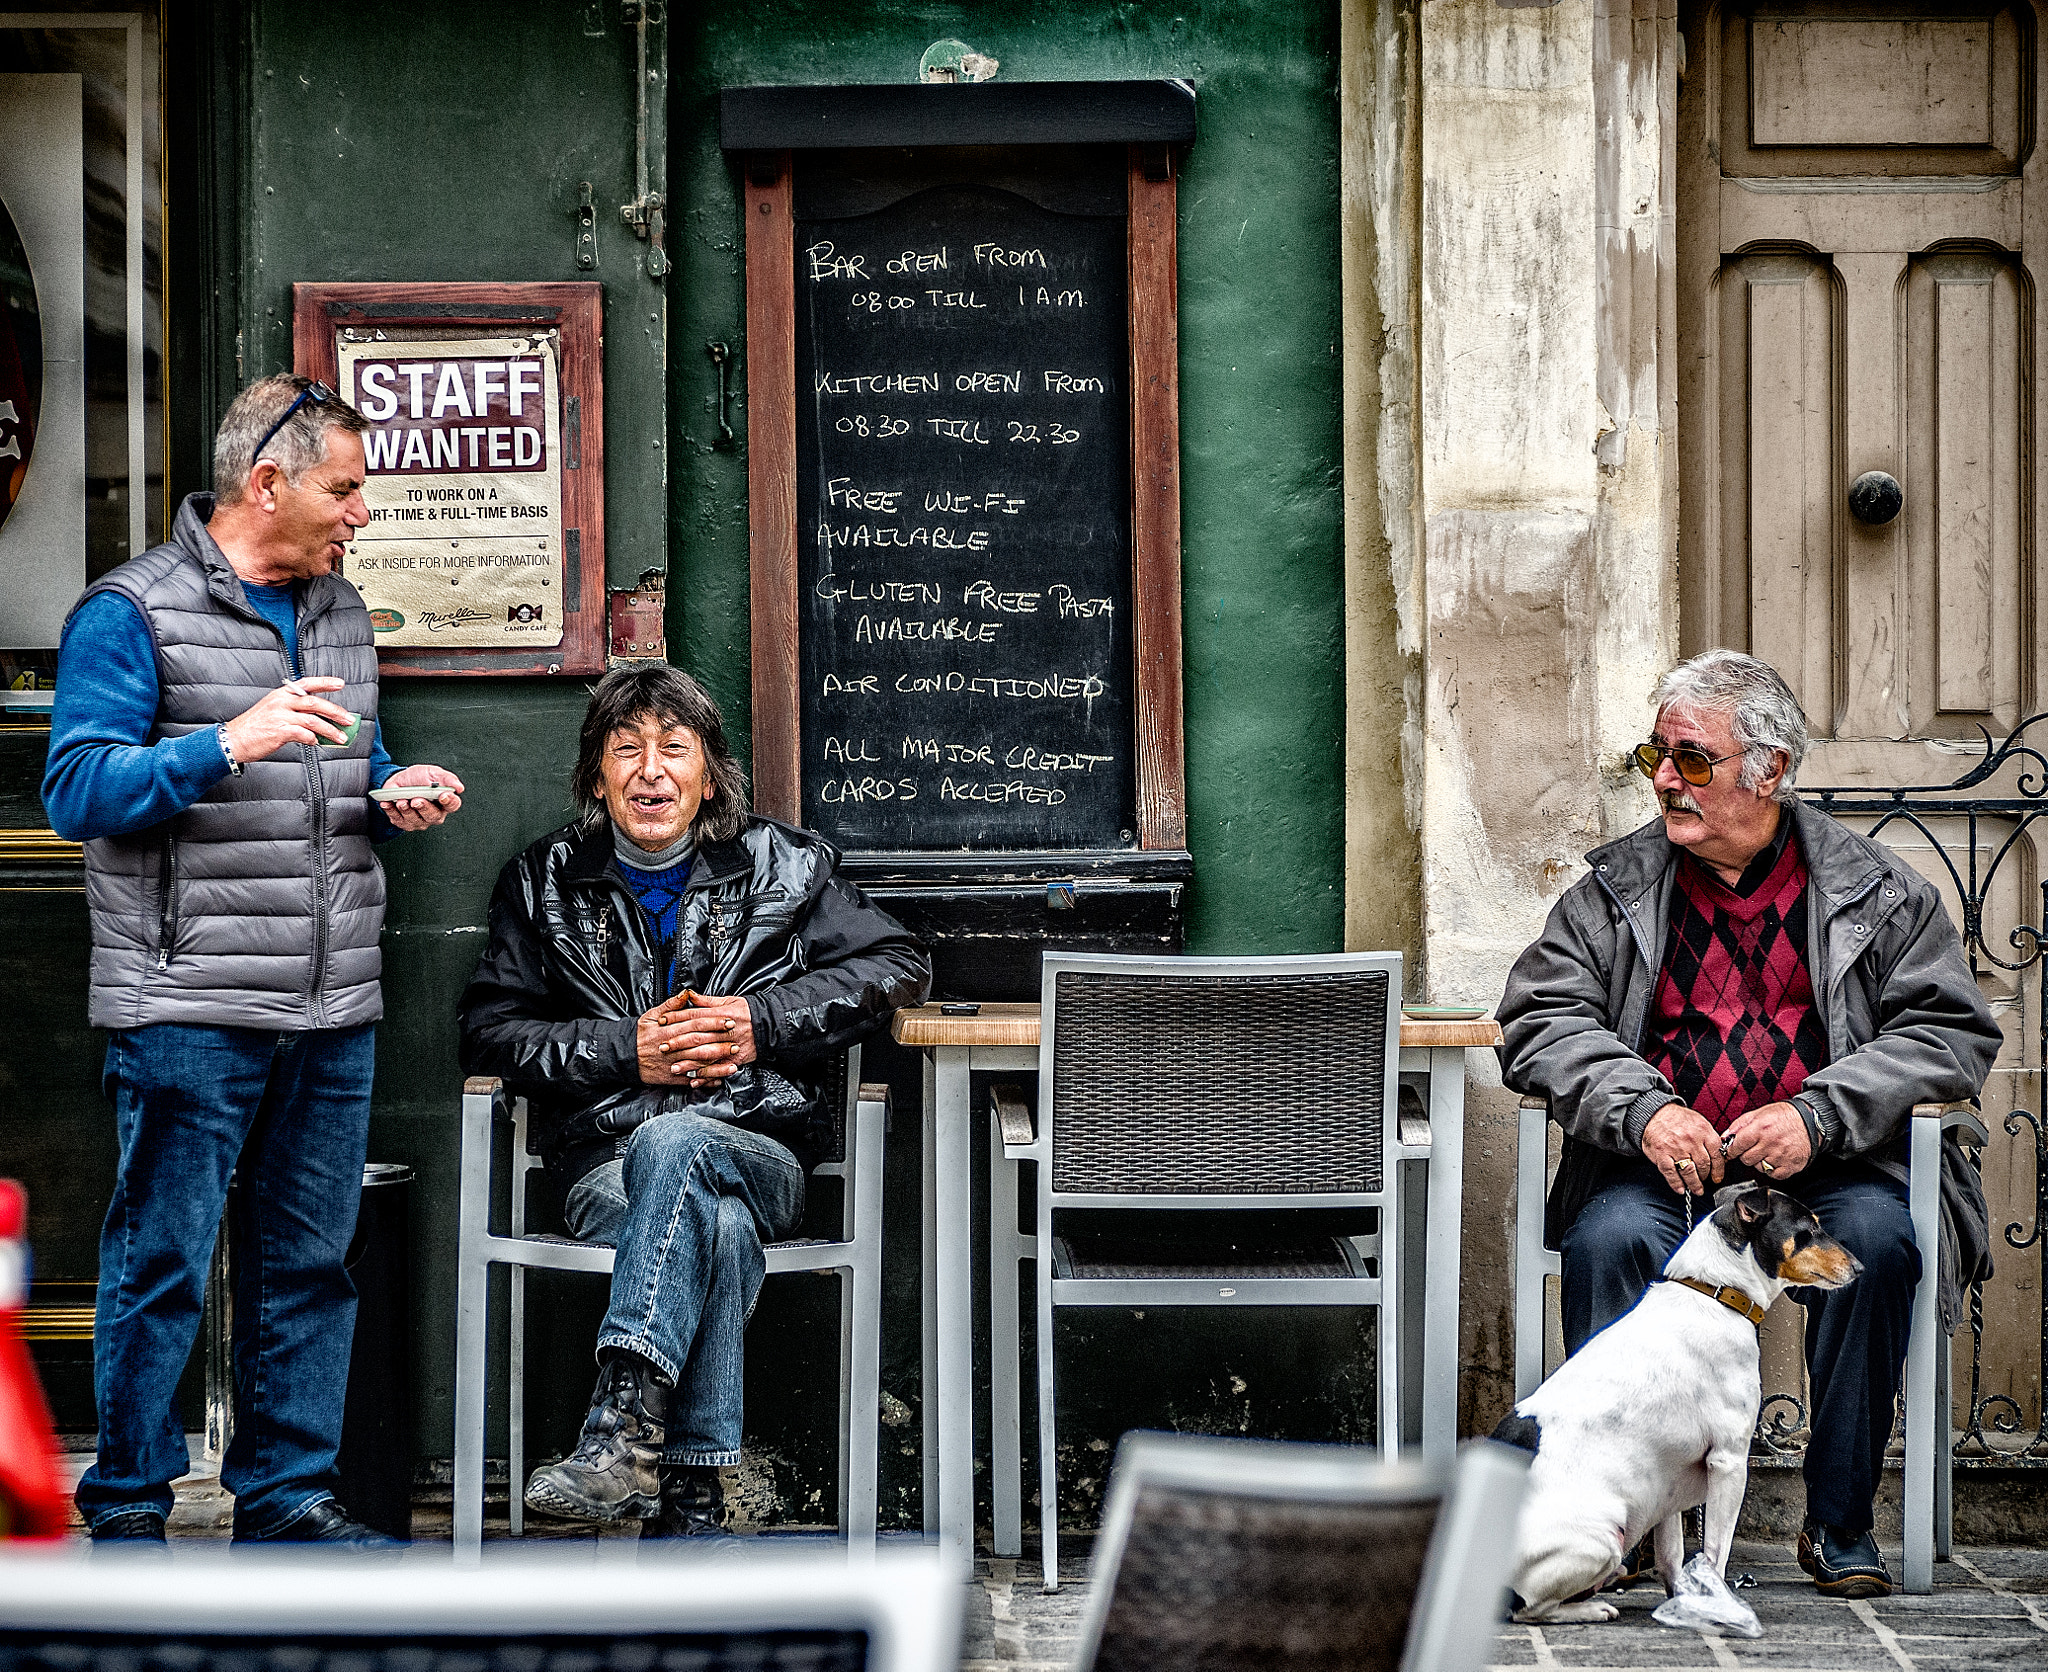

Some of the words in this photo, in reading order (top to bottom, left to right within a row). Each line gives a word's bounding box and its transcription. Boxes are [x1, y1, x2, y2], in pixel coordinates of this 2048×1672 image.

[806, 241, 869, 281] BAR
[887, 246, 948, 273] OPEN
[926, 290, 986, 308] TILL
[360, 361, 541, 421] STAFF
[815, 370, 939, 394] KITCHEN
[955, 371, 1021, 393] OPEN
[927, 419, 989, 444] TILL
[362, 426, 542, 469] WANTED
[407, 490, 423, 502] TO
[427, 489, 463, 501] WORK
[467, 489, 485, 500] ON
[488, 489, 497, 500] A
[827, 478, 903, 513] FREE
[368, 509, 424, 521] RT-TIME
[428, 508, 437, 520] &
[441, 507, 507, 520] FULL-TIME
[511, 505, 548, 518] BASIS
[818, 524, 989, 551] AVAILABLE
[358, 558, 378, 569] ASK
[382, 557, 416, 569] INSIDE
[419, 556, 440, 568] FOR
[444, 556, 475, 568] MORE
[478, 555, 550, 567] INFORMATION
[816, 574, 941, 604] GLUTEN
[963, 580, 1042, 613] FREE
[1048, 584, 1115, 619] PASTA
[855, 615, 1003, 643] AVAILABLE
[823, 673, 880, 696] AIR
[895, 672, 1104, 699] CONDITIONED
[824, 736, 880, 764] ALL
[902, 735, 995, 765] MAJOR
[1006, 746, 1114, 772] CREDIT
[821, 777, 918, 804] CARDS
[940, 776, 1066, 806] ACCEPTED
